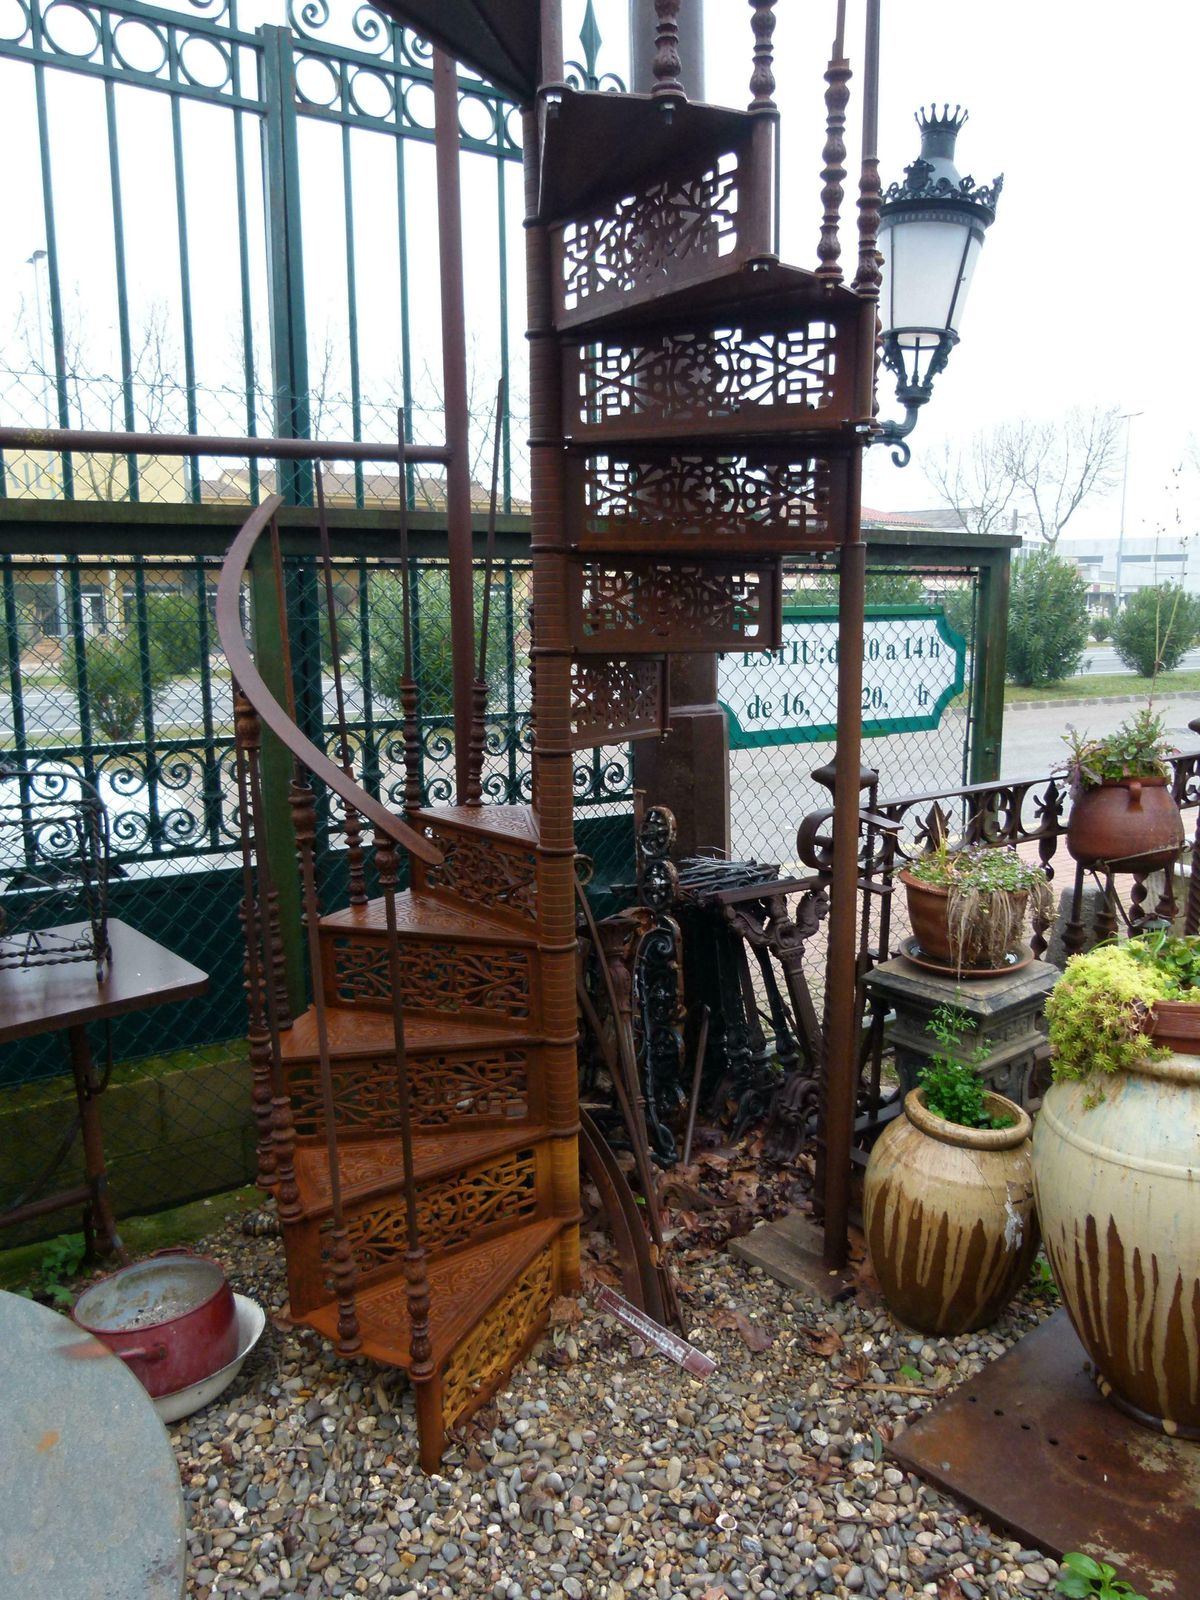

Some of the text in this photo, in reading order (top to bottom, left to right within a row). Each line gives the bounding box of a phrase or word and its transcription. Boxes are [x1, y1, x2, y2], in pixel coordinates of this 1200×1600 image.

[886, 644, 898, 660] a
[904, 636, 923, 659] 14
[929, 636, 940, 658] h
[747, 694, 773, 719] de
[917, 683, 928, 706] h
